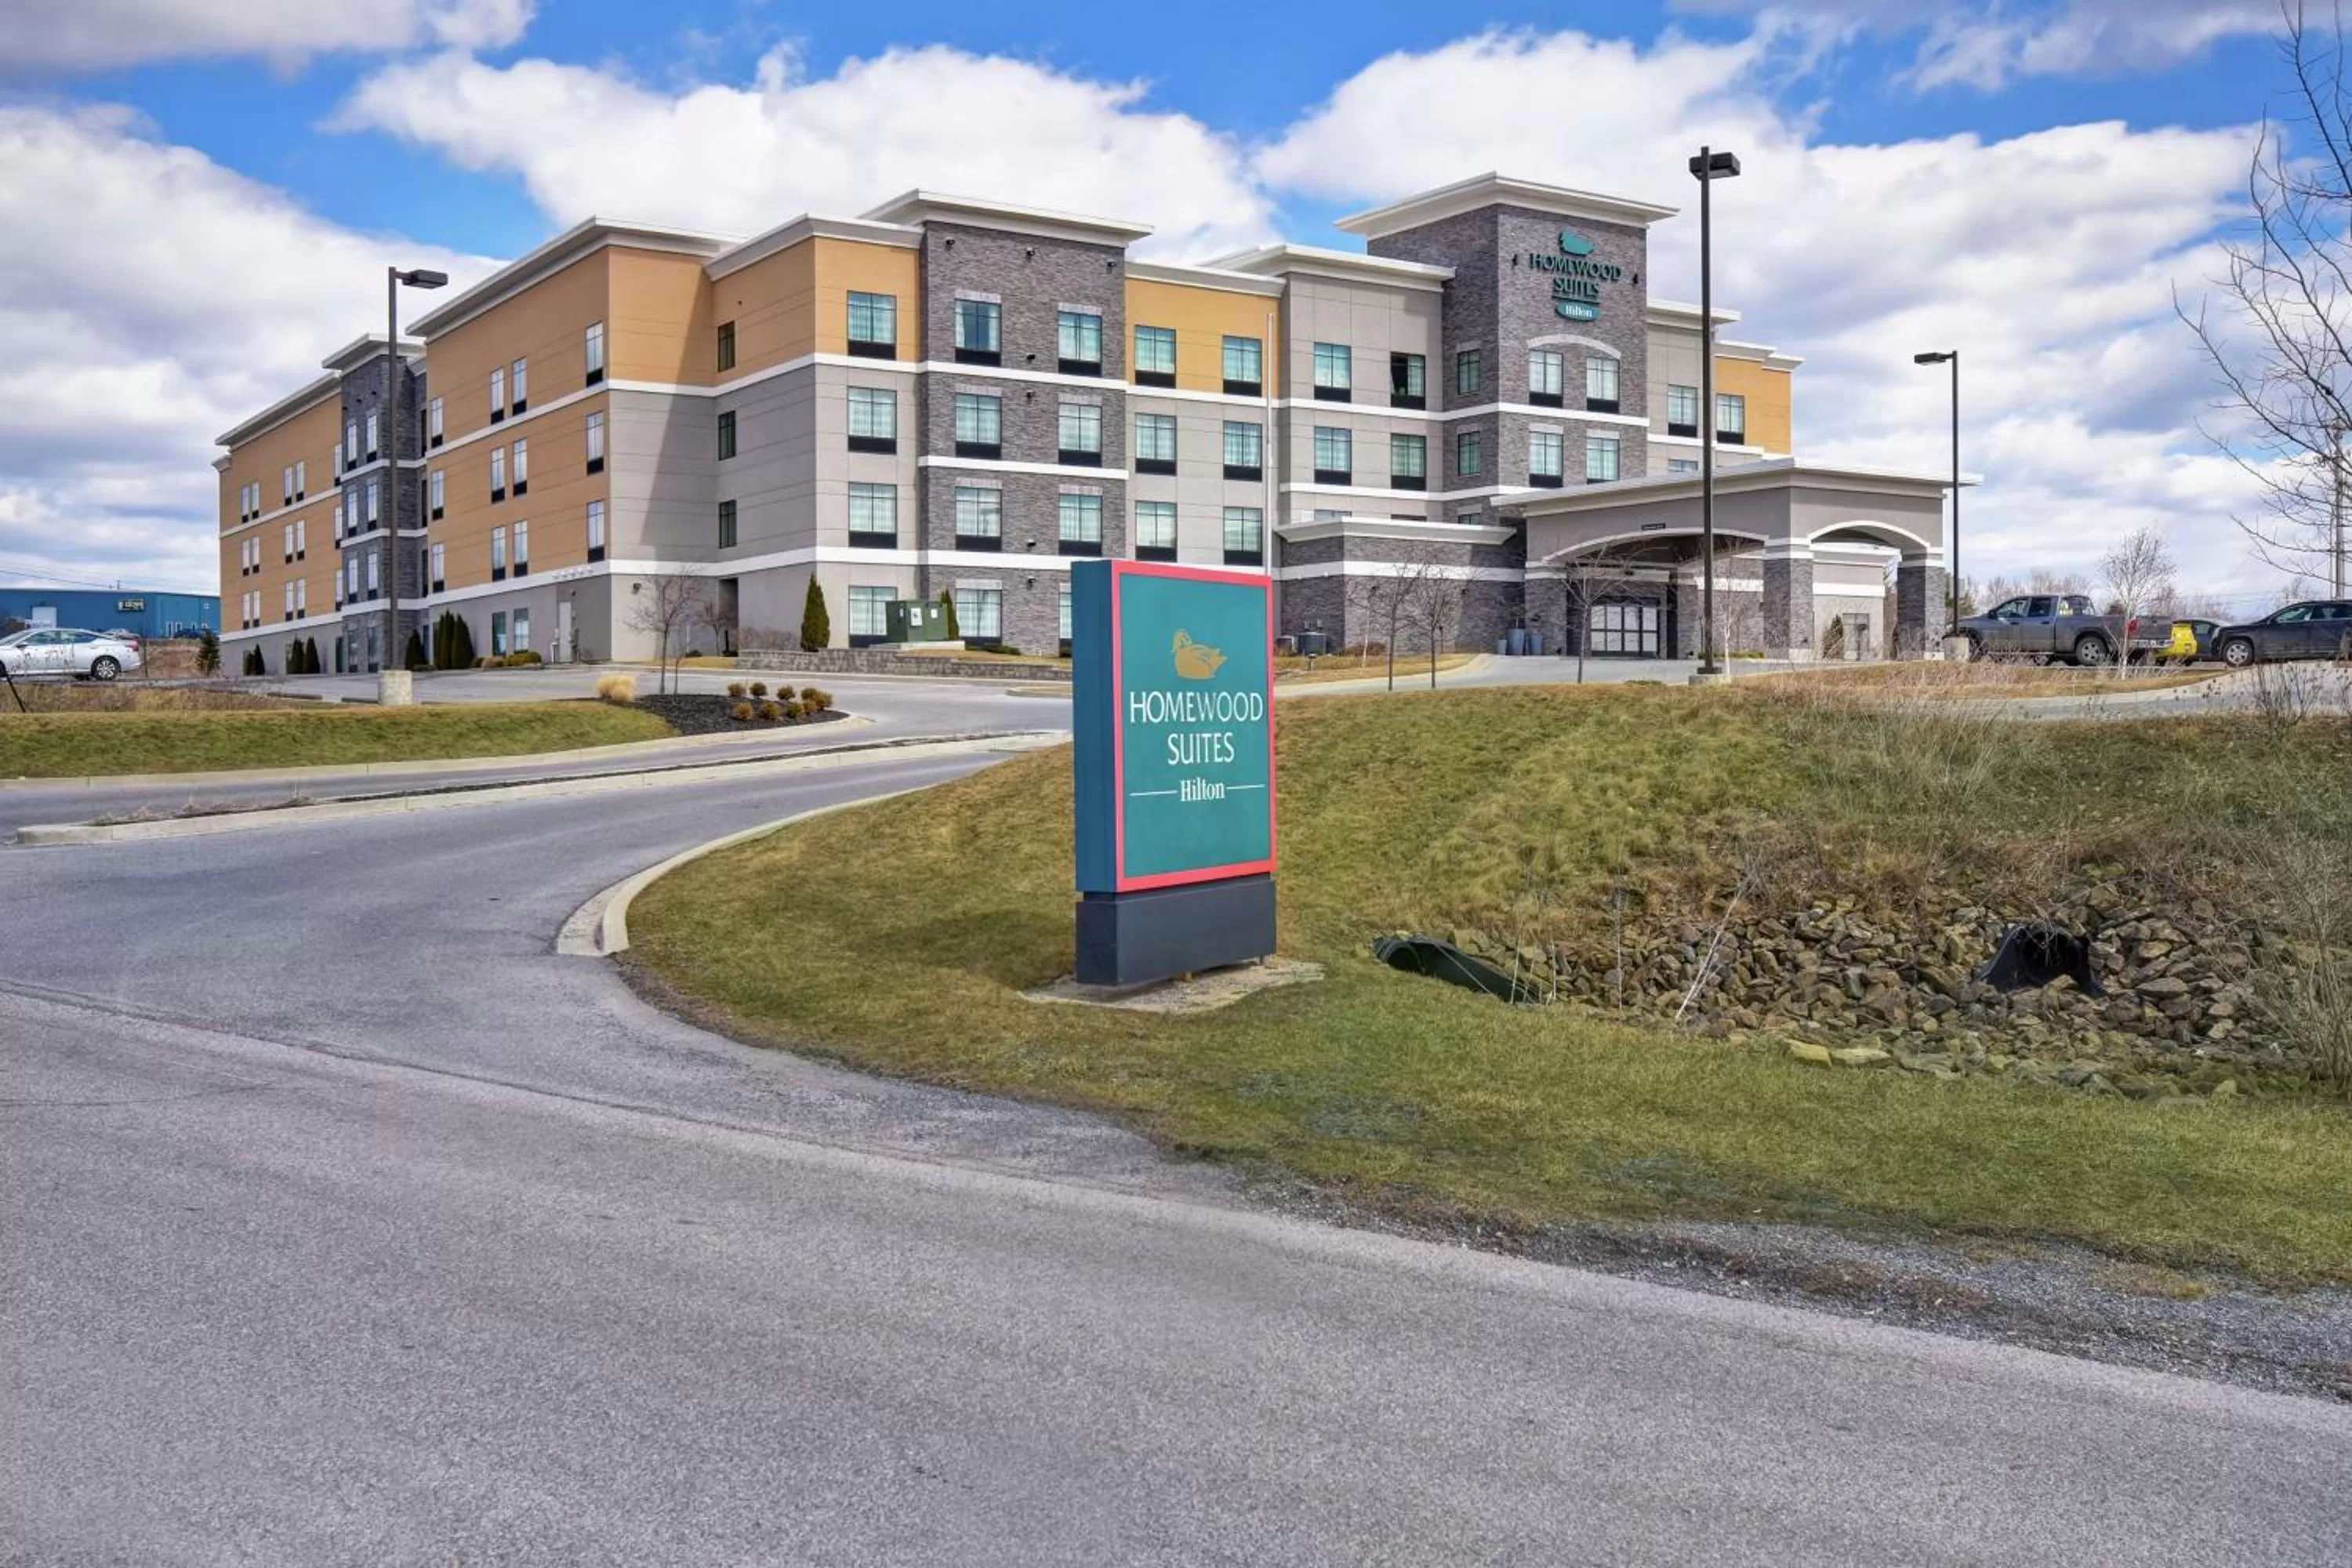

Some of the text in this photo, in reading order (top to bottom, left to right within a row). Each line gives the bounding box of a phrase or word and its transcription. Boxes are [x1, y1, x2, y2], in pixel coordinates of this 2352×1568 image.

[1530, 252, 1623, 282] HOMEWOOD
[1552, 278, 1601, 299] SUITES
[1565, 304, 1593, 318] Hilton
[1130, 691, 1264, 724] HOMEWOOD
[1167, 731, 1235, 766] SUITES
[1179, 776, 1225, 802] Hilton
